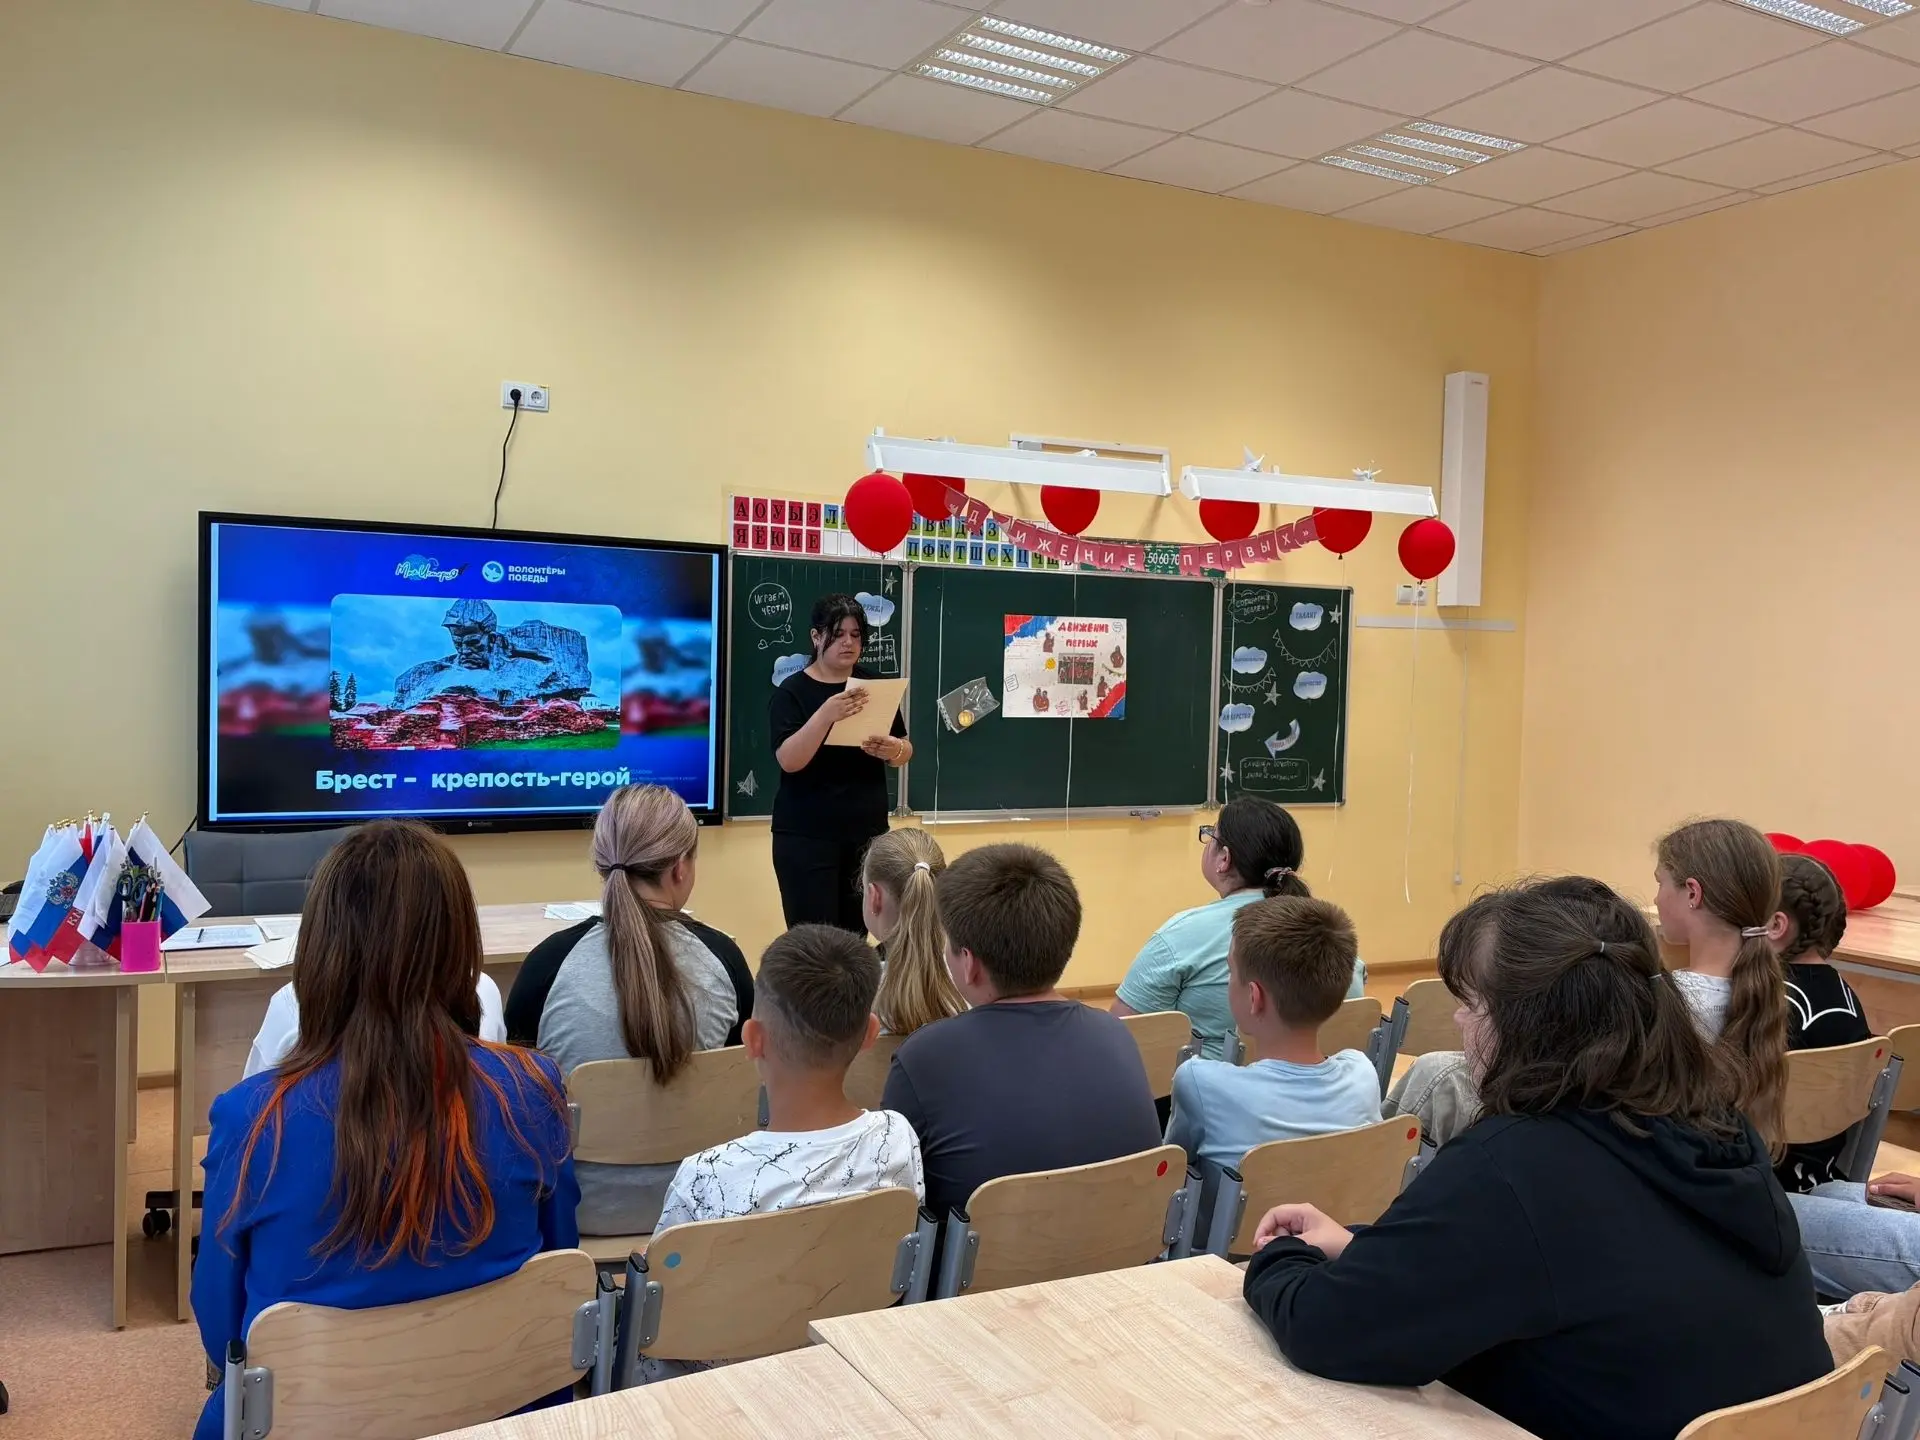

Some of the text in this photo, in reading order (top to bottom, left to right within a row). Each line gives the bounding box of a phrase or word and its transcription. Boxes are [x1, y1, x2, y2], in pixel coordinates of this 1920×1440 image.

[508, 565, 566, 576] ВОЛОНТЁРЫ
[508, 574, 549, 583] ПОБЕДЫ
[315, 770, 397, 793] Брест
[431, 766, 631, 792] крепость-герой
